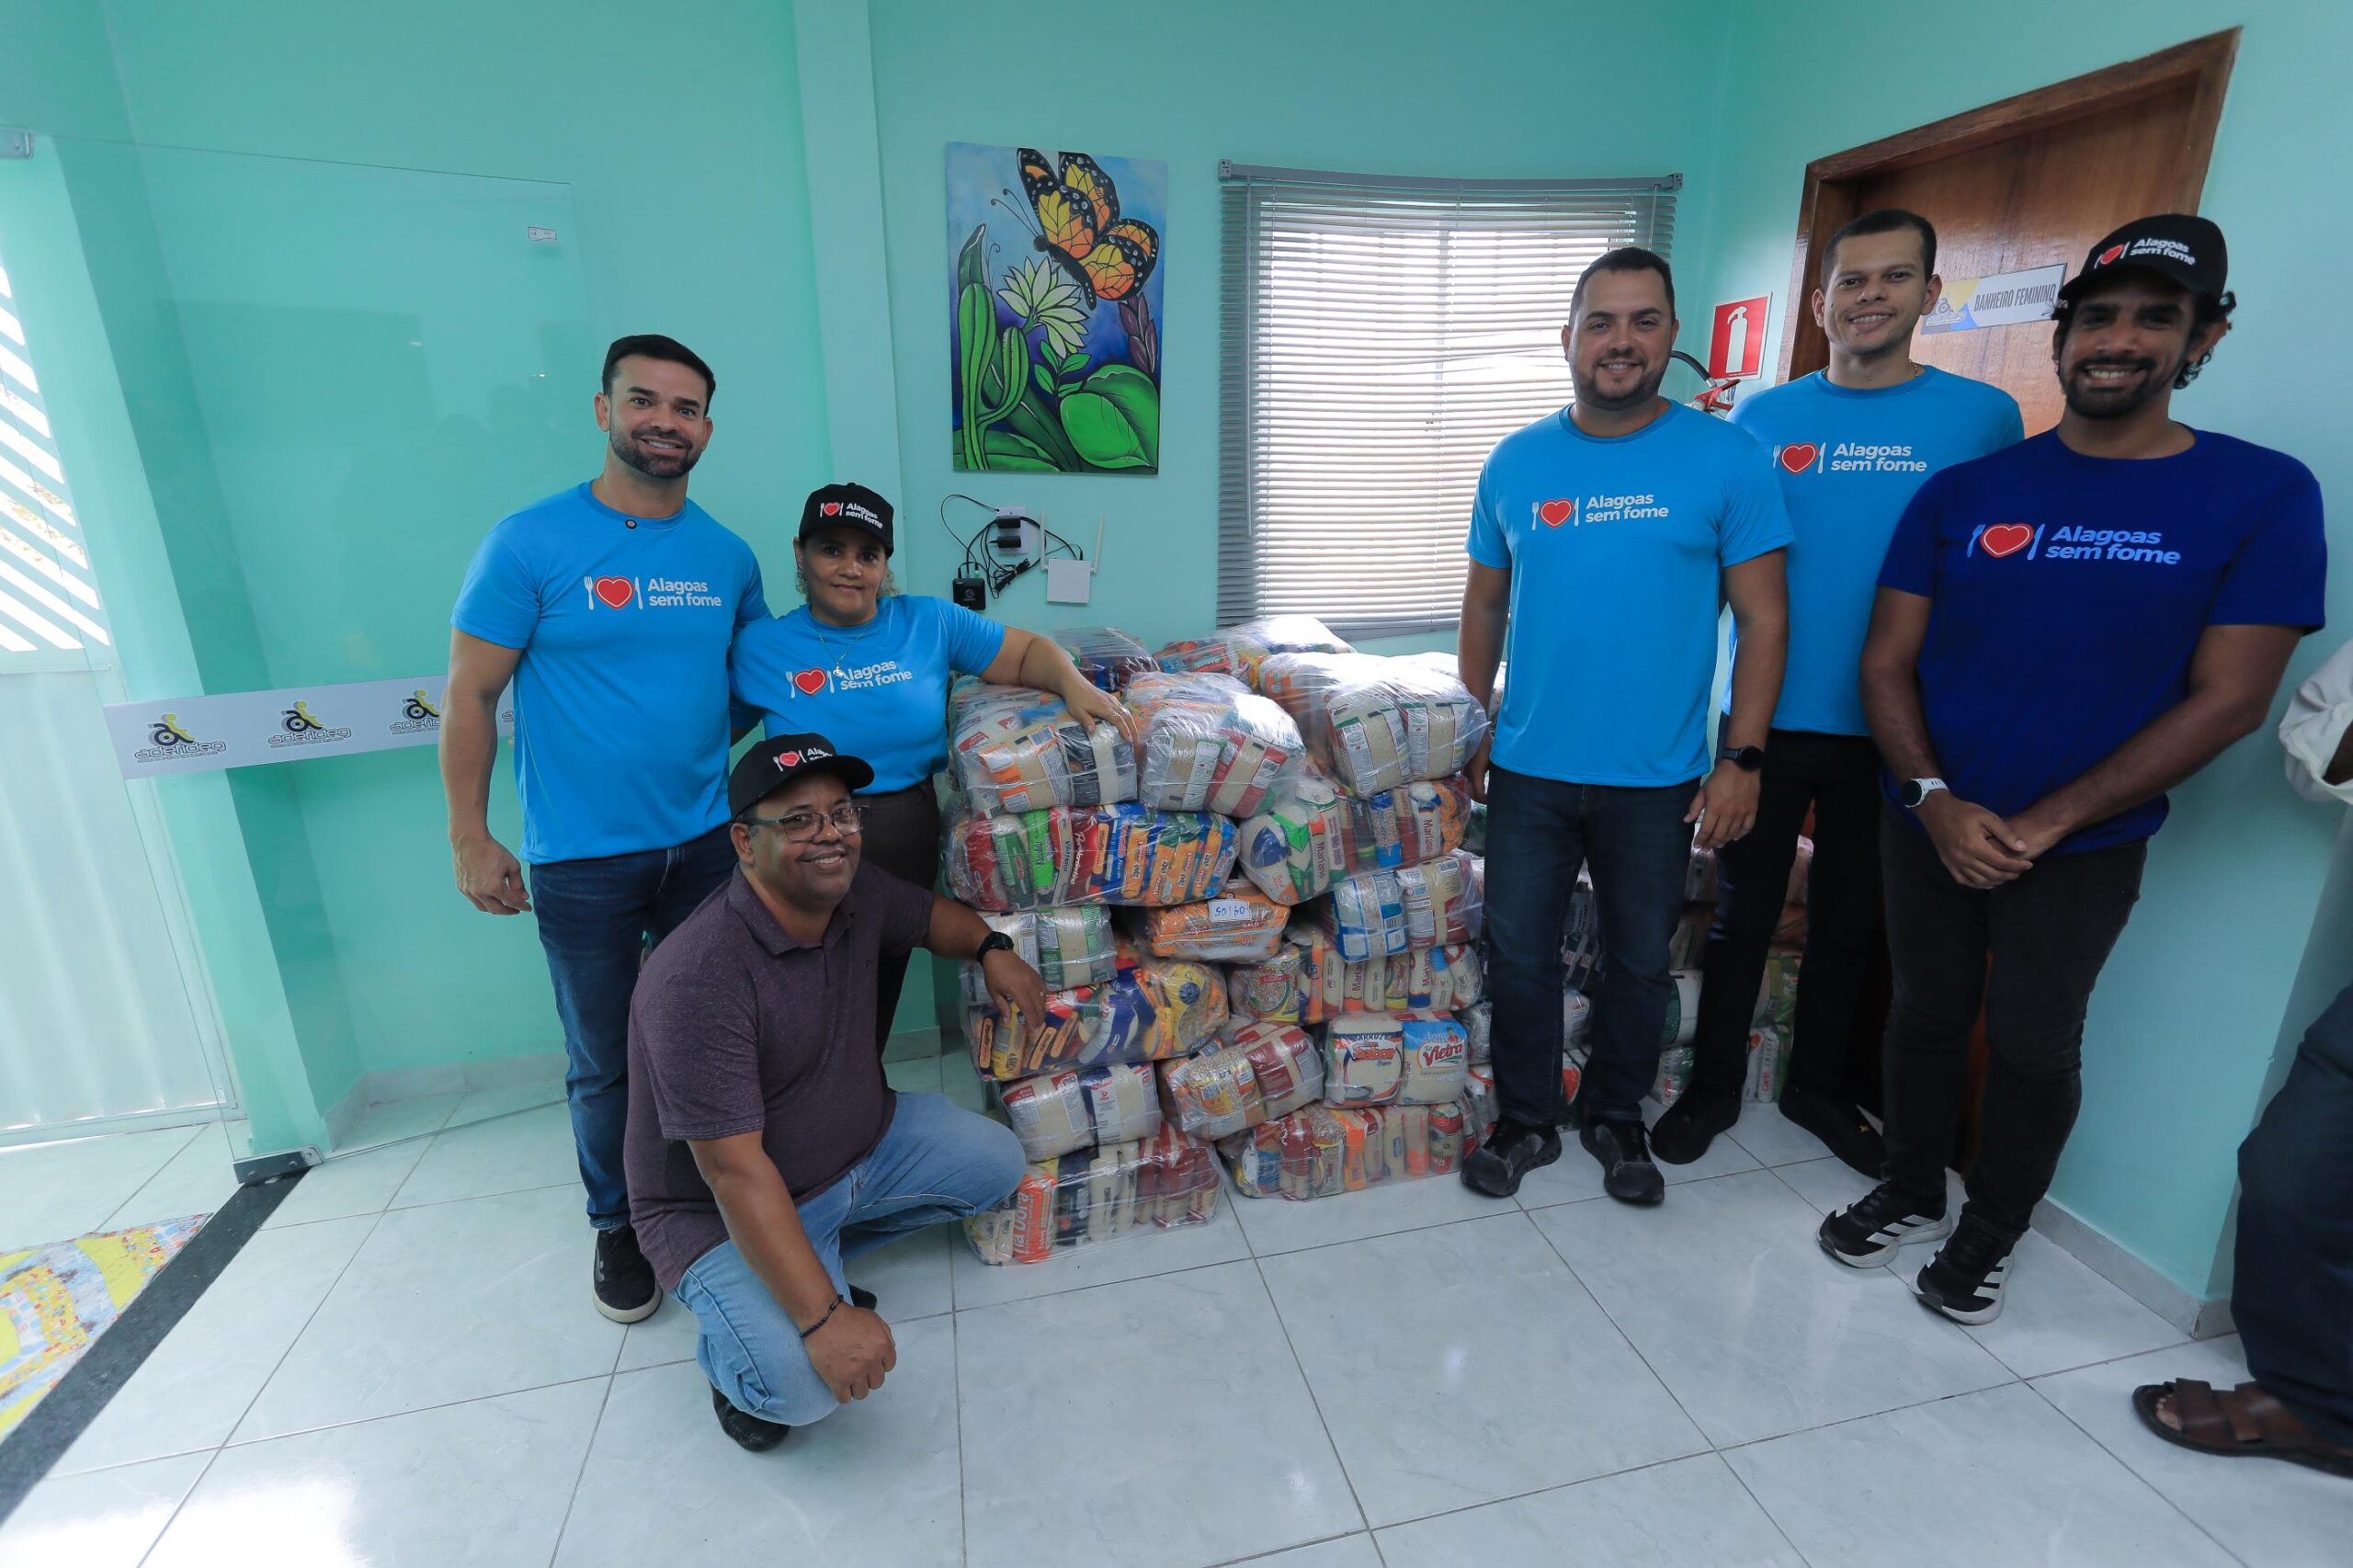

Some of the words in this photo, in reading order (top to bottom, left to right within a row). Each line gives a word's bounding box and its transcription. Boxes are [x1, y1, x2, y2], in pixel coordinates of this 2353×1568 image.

[2134, 238, 2190, 253] Alagoas
[2130, 247, 2161, 256] sem
[2163, 248, 2196, 266] fome
[1974, 290, 2015, 312] BANHEIRO
[2015, 283, 2057, 307] FEMININO
[1833, 442, 1912, 460] Alagoas
[1830, 459, 1872, 472] sem
[1875, 457, 1927, 472] fome
[846, 503, 879, 519] Alagoas
[1586, 494, 1654, 510] Alagoas
[845, 511, 864, 520] sem
[864, 516, 883, 529] fome
[1586, 510, 1620, 523] sem
[1623, 506, 1669, 520] fome
[2051, 526, 2163, 546] Alagoas
[2045, 544, 2095, 560] sem
[2107, 543, 2181, 565] fome
[647, 578, 708, 595] Alagoas
[649, 596, 684, 607] sem
[686, 593, 722, 607] fome
[840, 679, 874, 690] sem
[875, 670, 913, 687] fome
[1423, 818, 1433, 852] Mariano
[1316, 841, 1326, 879] Mariano
